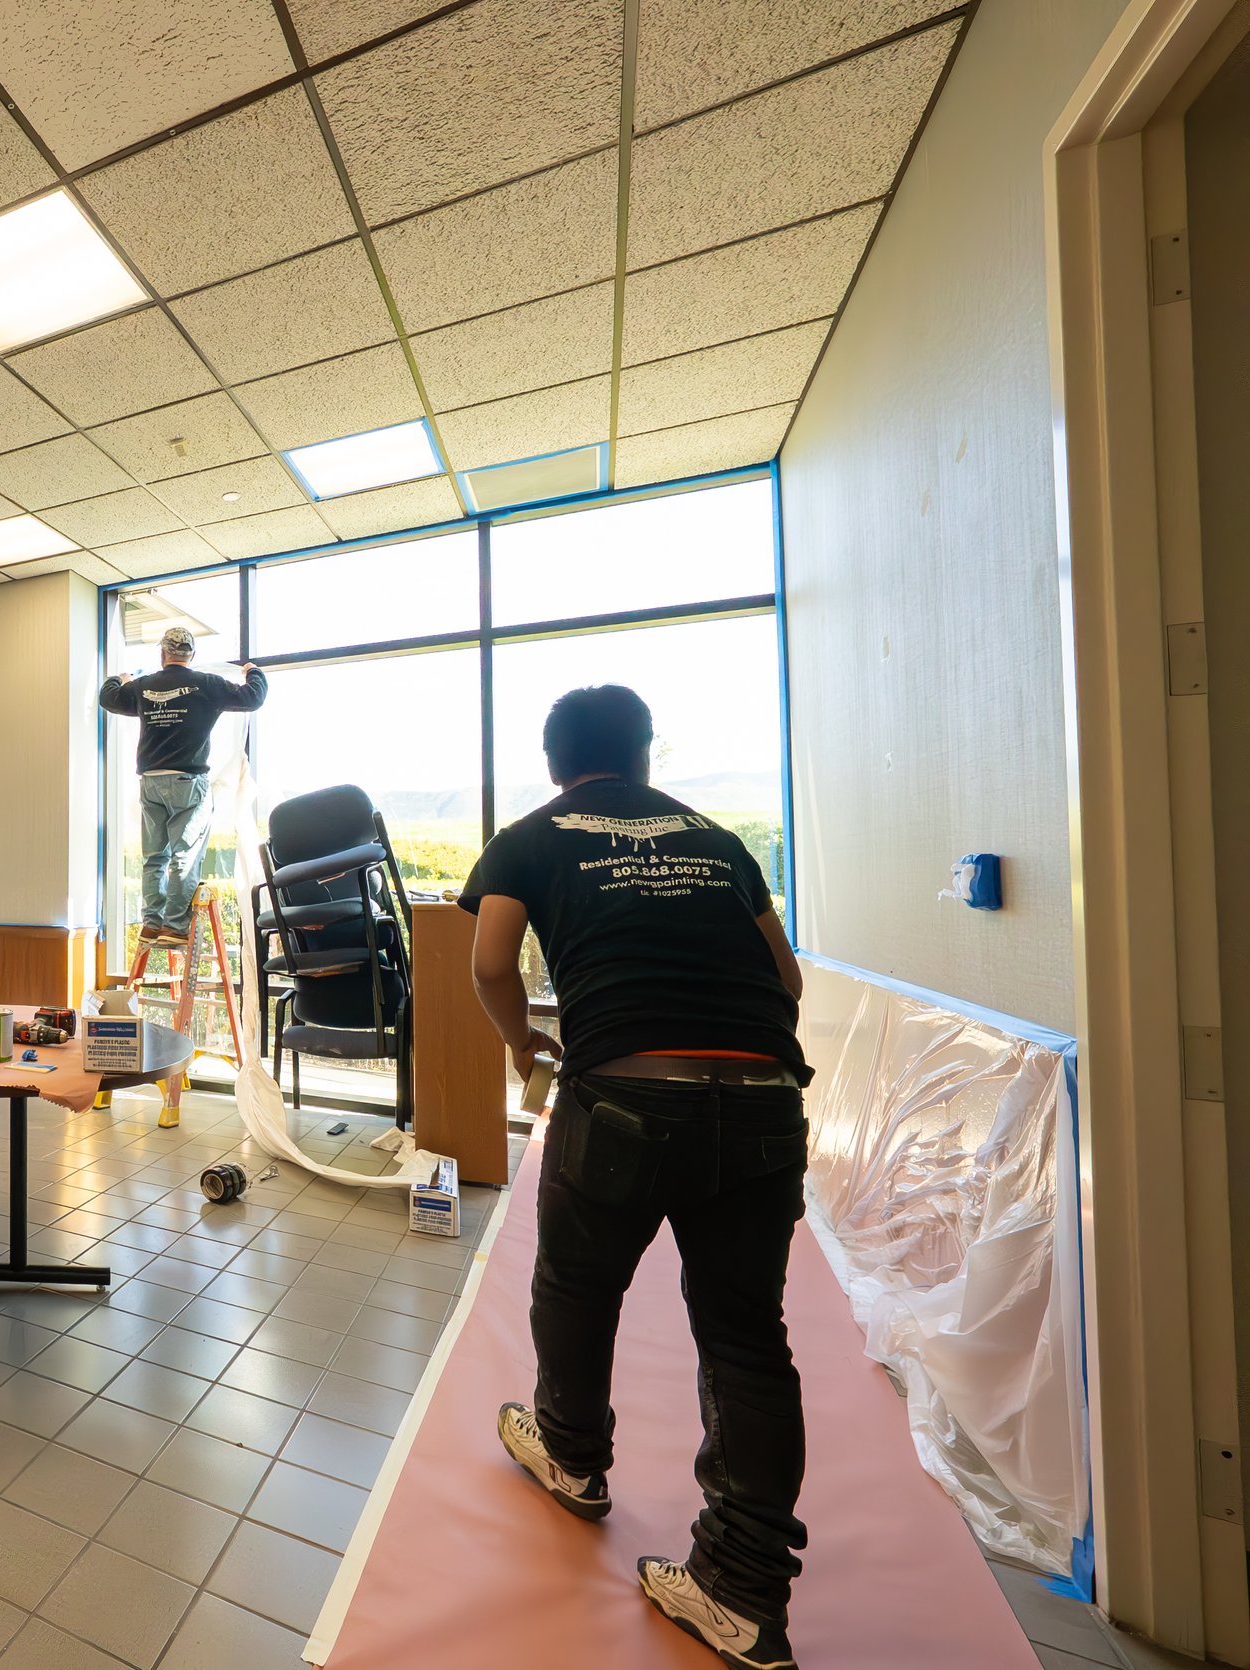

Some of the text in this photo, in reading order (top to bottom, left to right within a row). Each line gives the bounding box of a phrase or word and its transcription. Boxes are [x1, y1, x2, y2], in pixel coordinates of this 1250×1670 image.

[610, 815, 679, 827] GENERATION
[601, 823, 668, 836] Painting Inc
[579, 855, 732, 871] Residential & Commercial
[612, 865, 711, 878] 805.868.0075
[599, 876, 732, 892] www.newgpainting.com
